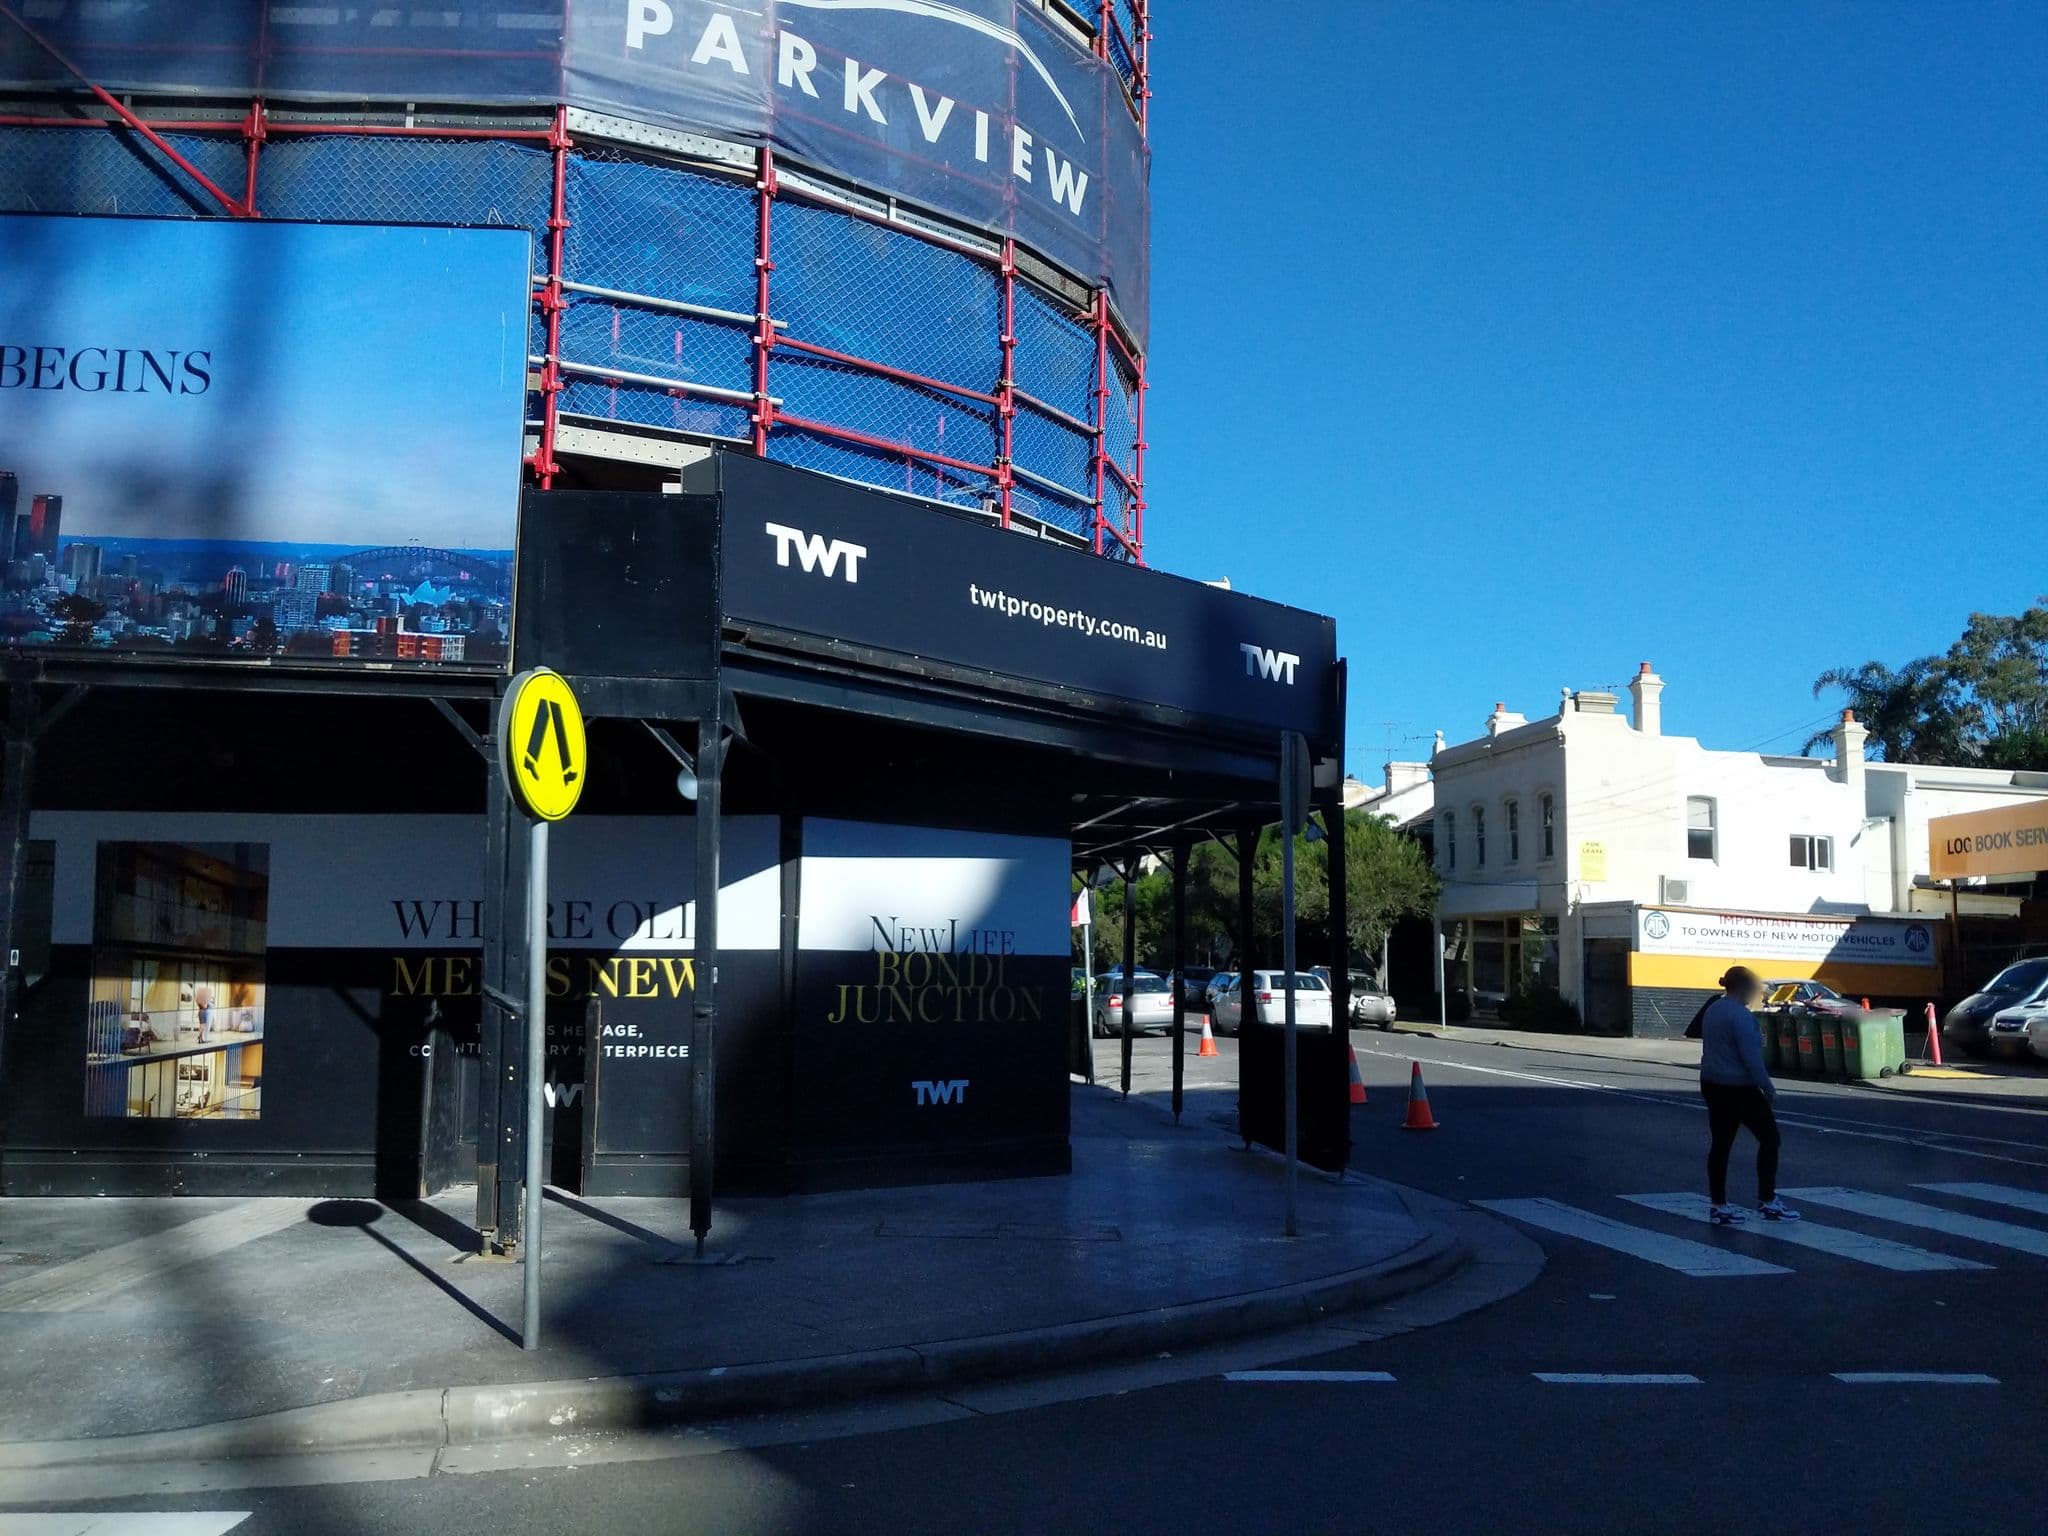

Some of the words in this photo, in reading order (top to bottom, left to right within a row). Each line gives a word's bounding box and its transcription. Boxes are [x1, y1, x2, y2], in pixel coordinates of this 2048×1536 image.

[625, 0, 1089, 216] PARKVIEW
[0, 346, 211, 394] BEGINS
[766, 522, 868, 583] TWT
[969, 583, 1168, 650] twtproperty.com.au
[1240, 642, 1301, 685] TWT
[1947, 837, 1973, 855] LOG
[1975, 831, 2013, 851] BOOK
[606, 900, 696, 939] OL
[1681, 926, 1697, 936] TO
[1699, 927, 1750, 939] OWNERS
[1753, 930, 1767, 939] OF
[1771, 931, 1798, 940] NEW
[1802, 933, 1841, 943] MOTOR
[1843, 934, 1896, 946] VEHICLES
[588, 958, 696, 998] NEW
[876, 951, 1009, 989] BONDI
[827, 984, 1046, 1023] JUNCTION
[911, 1079, 970, 1105] TWT
